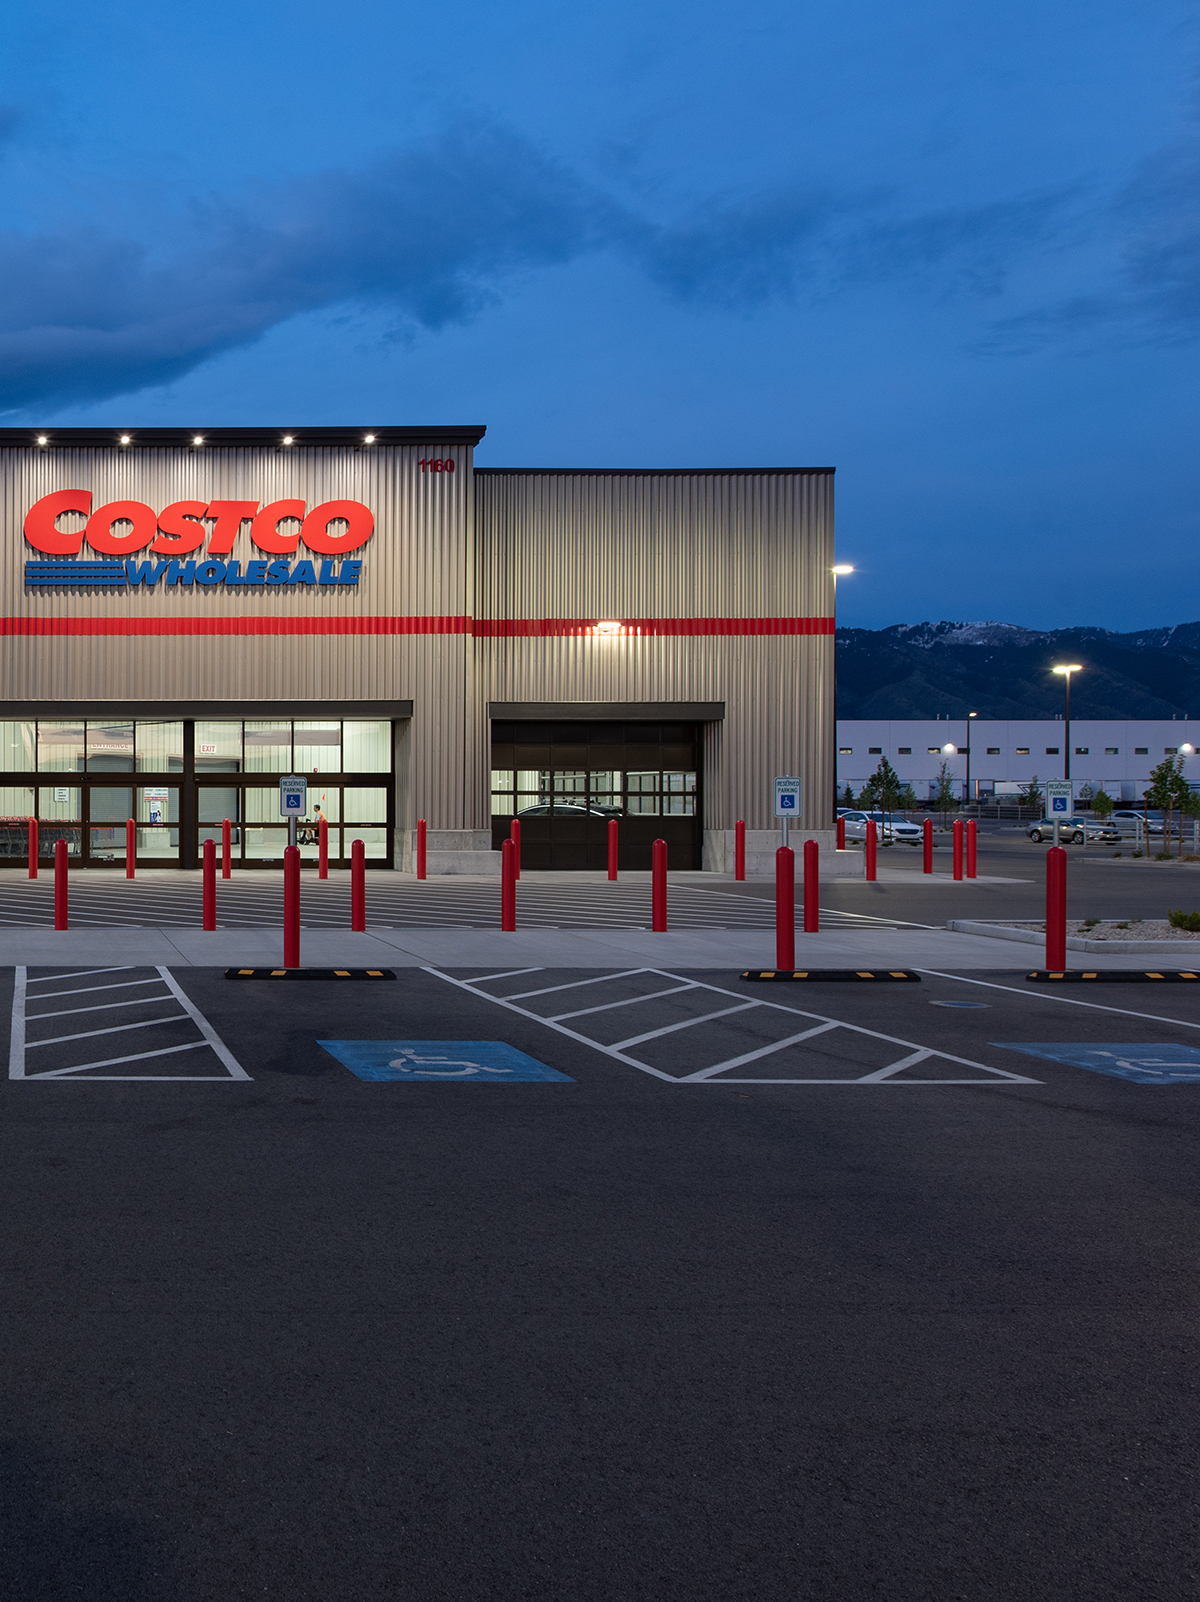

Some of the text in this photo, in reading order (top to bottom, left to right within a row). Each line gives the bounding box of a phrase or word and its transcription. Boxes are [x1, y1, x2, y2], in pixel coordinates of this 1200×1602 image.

[418, 458, 454, 473] 1160
[24, 489, 374, 554] COSTCO
[125, 560, 362, 585] WHOLESALE
